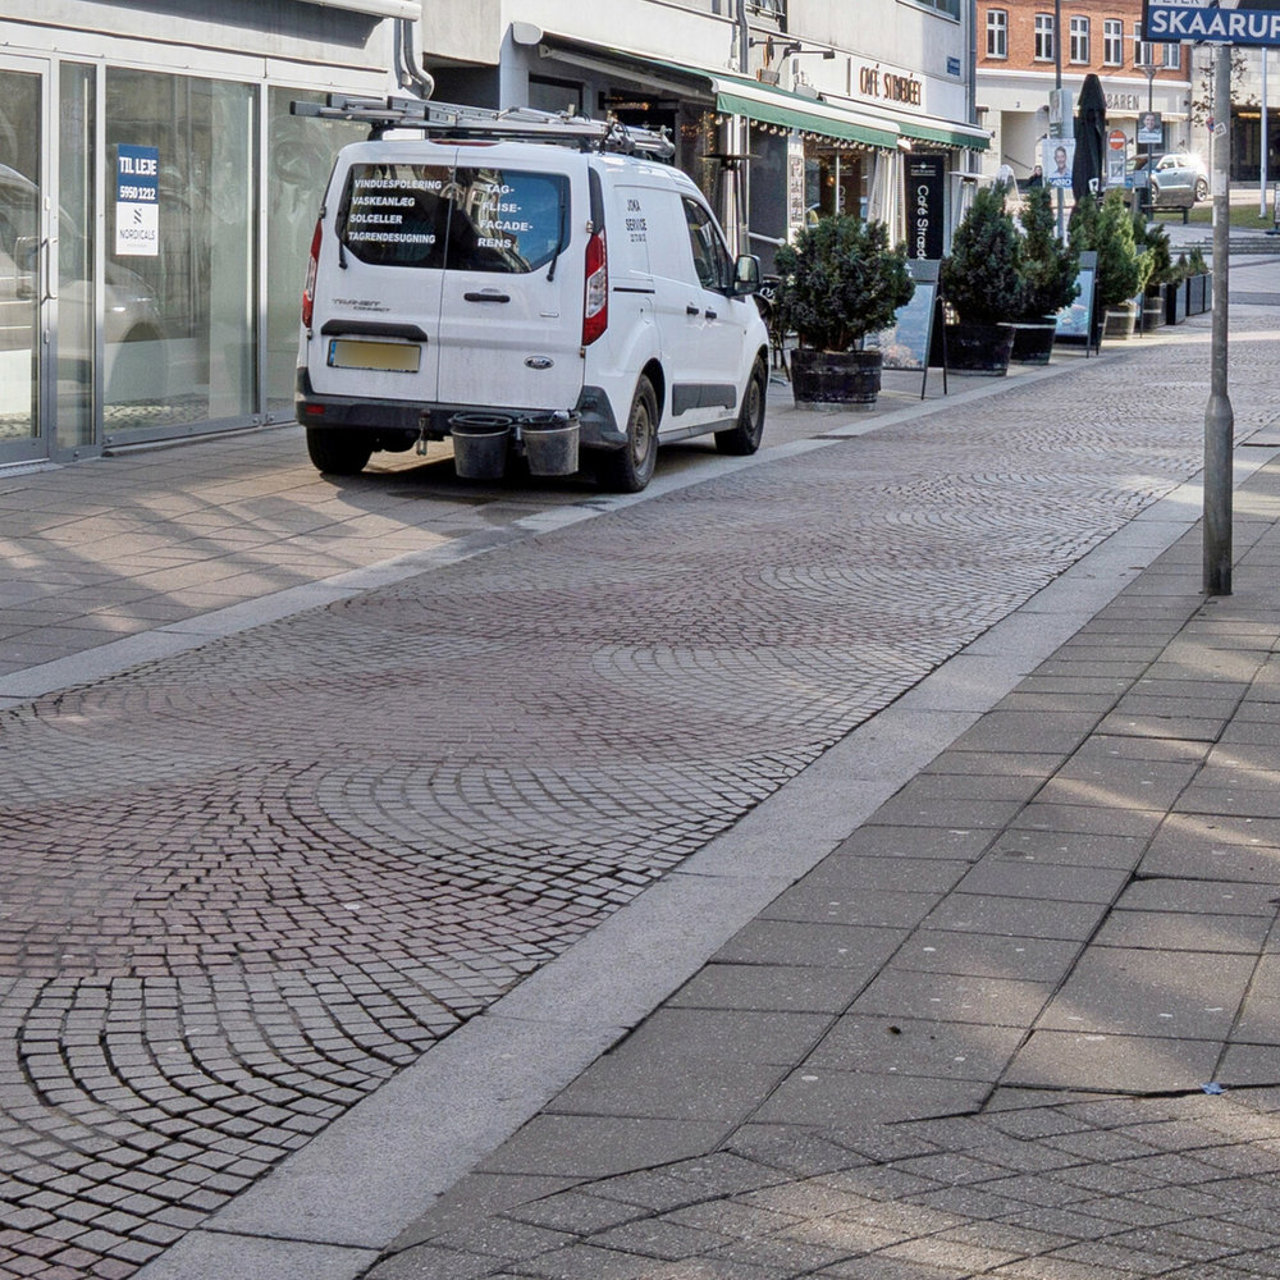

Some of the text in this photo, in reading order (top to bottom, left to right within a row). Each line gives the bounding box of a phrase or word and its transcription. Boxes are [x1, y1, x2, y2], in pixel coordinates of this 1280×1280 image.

[860, 63, 880, 98] CAFÉ
[1106, 94, 1139, 110] BAREN
[119, 156, 158, 176] TIL LEJE
[355, 179, 442, 190] VINDUESPOLERING
[486, 184, 515, 194] TAG-
[352, 196, 415, 207] VASKEANLÆG
[917, 185, 929, 215] Café
[483, 202, 522, 213] FLISE-
[350, 214, 403, 224] SOLCELLER
[480, 220, 534, 231] FACADE-
[120, 228, 155, 240] NORDICALS
[348, 231, 436, 244] TAGRENDESUGNING
[477, 238, 512, 248] RENS
